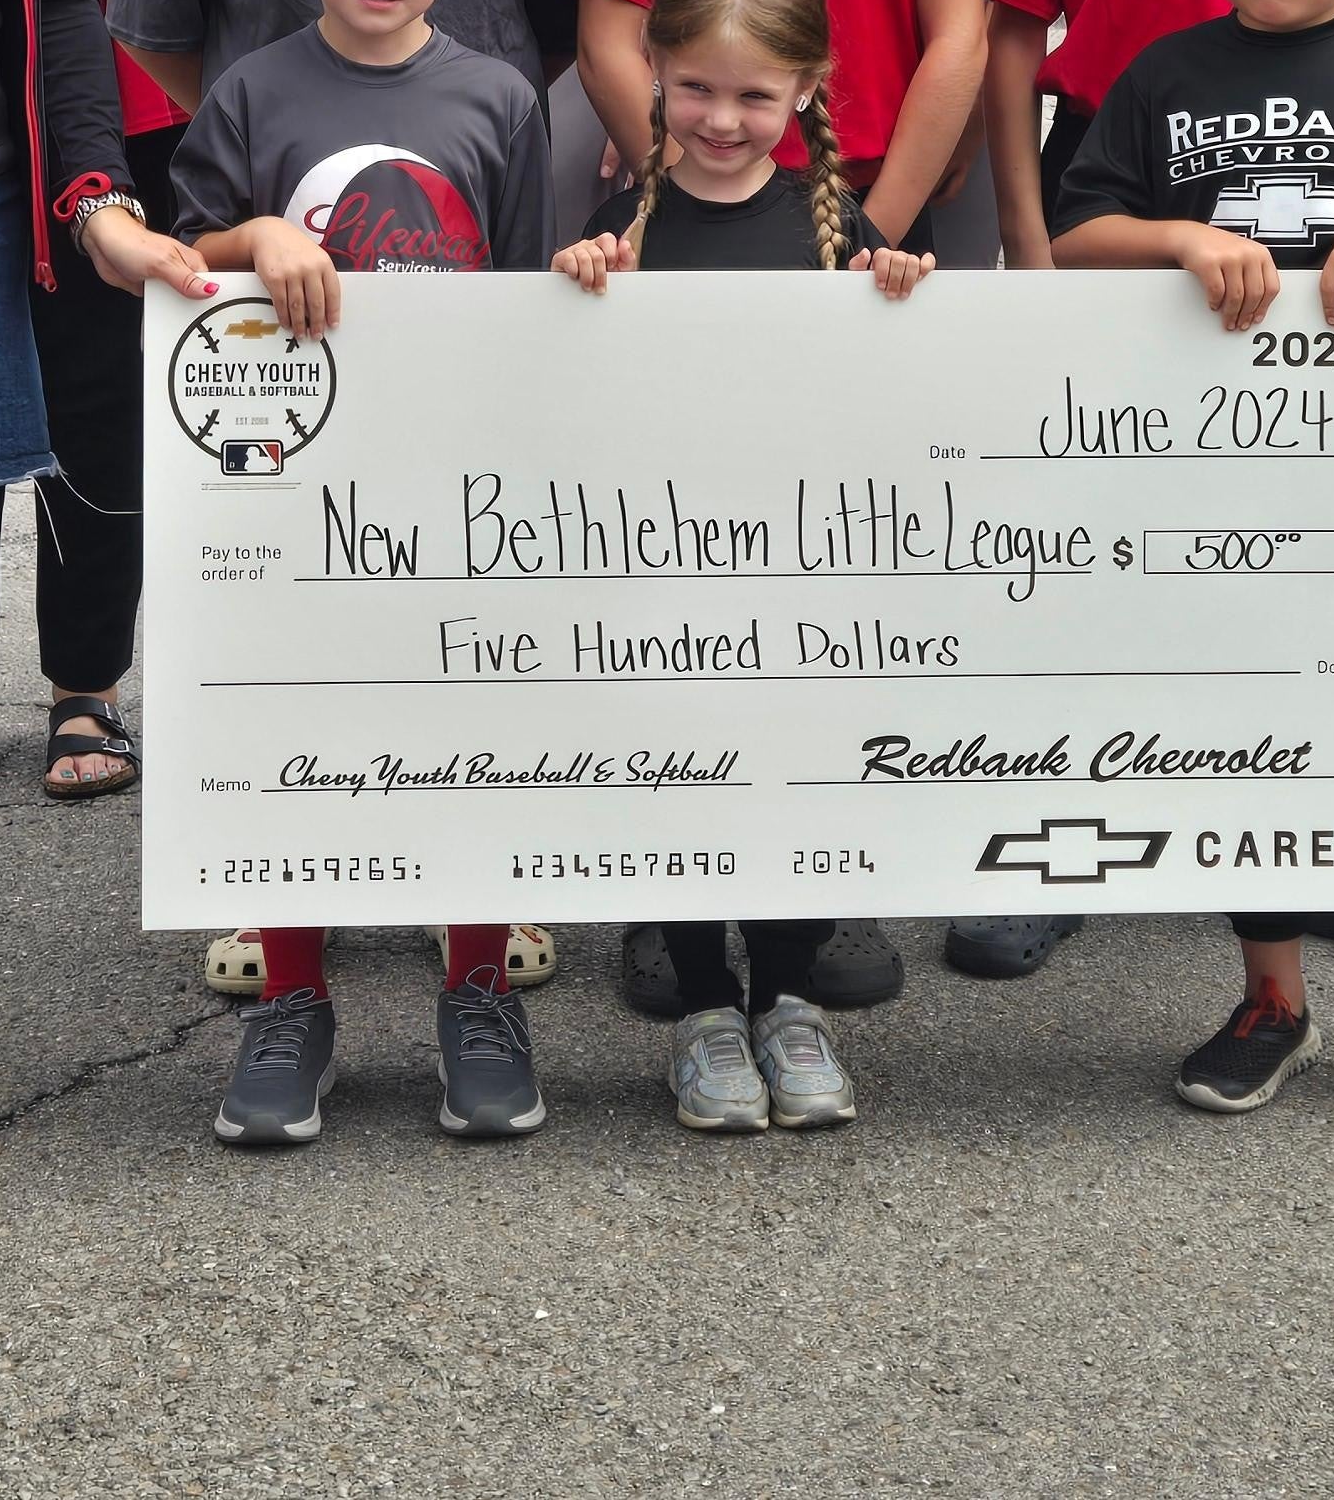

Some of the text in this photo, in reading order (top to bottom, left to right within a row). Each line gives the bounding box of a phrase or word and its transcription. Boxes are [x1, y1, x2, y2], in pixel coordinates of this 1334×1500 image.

[185, 362, 320, 384] CHEVY YOUTH
[185, 386, 245, 398] BASEBALL
[260, 386, 320, 397] SOFTBALL
[1039, 376, 1334, 457] June 2024
[929, 444, 966, 460] Date
[322, 473, 1097, 603] New Bethlehem Little League
[202, 545, 282, 563] Pay to the
[1112, 535, 1134, 572] $
[201, 565, 266, 581] order of
[439, 616, 960, 675] Five Hundred Dollars
[861, 730, 1313, 783] Redbank Chevrolet
[201, 777, 251, 793] Memo
[279, 750, 739, 797] Chevy Youth Baseball & Softball
[512, 851, 736, 878] 1234567890
[793, 850, 875, 875] 2024
